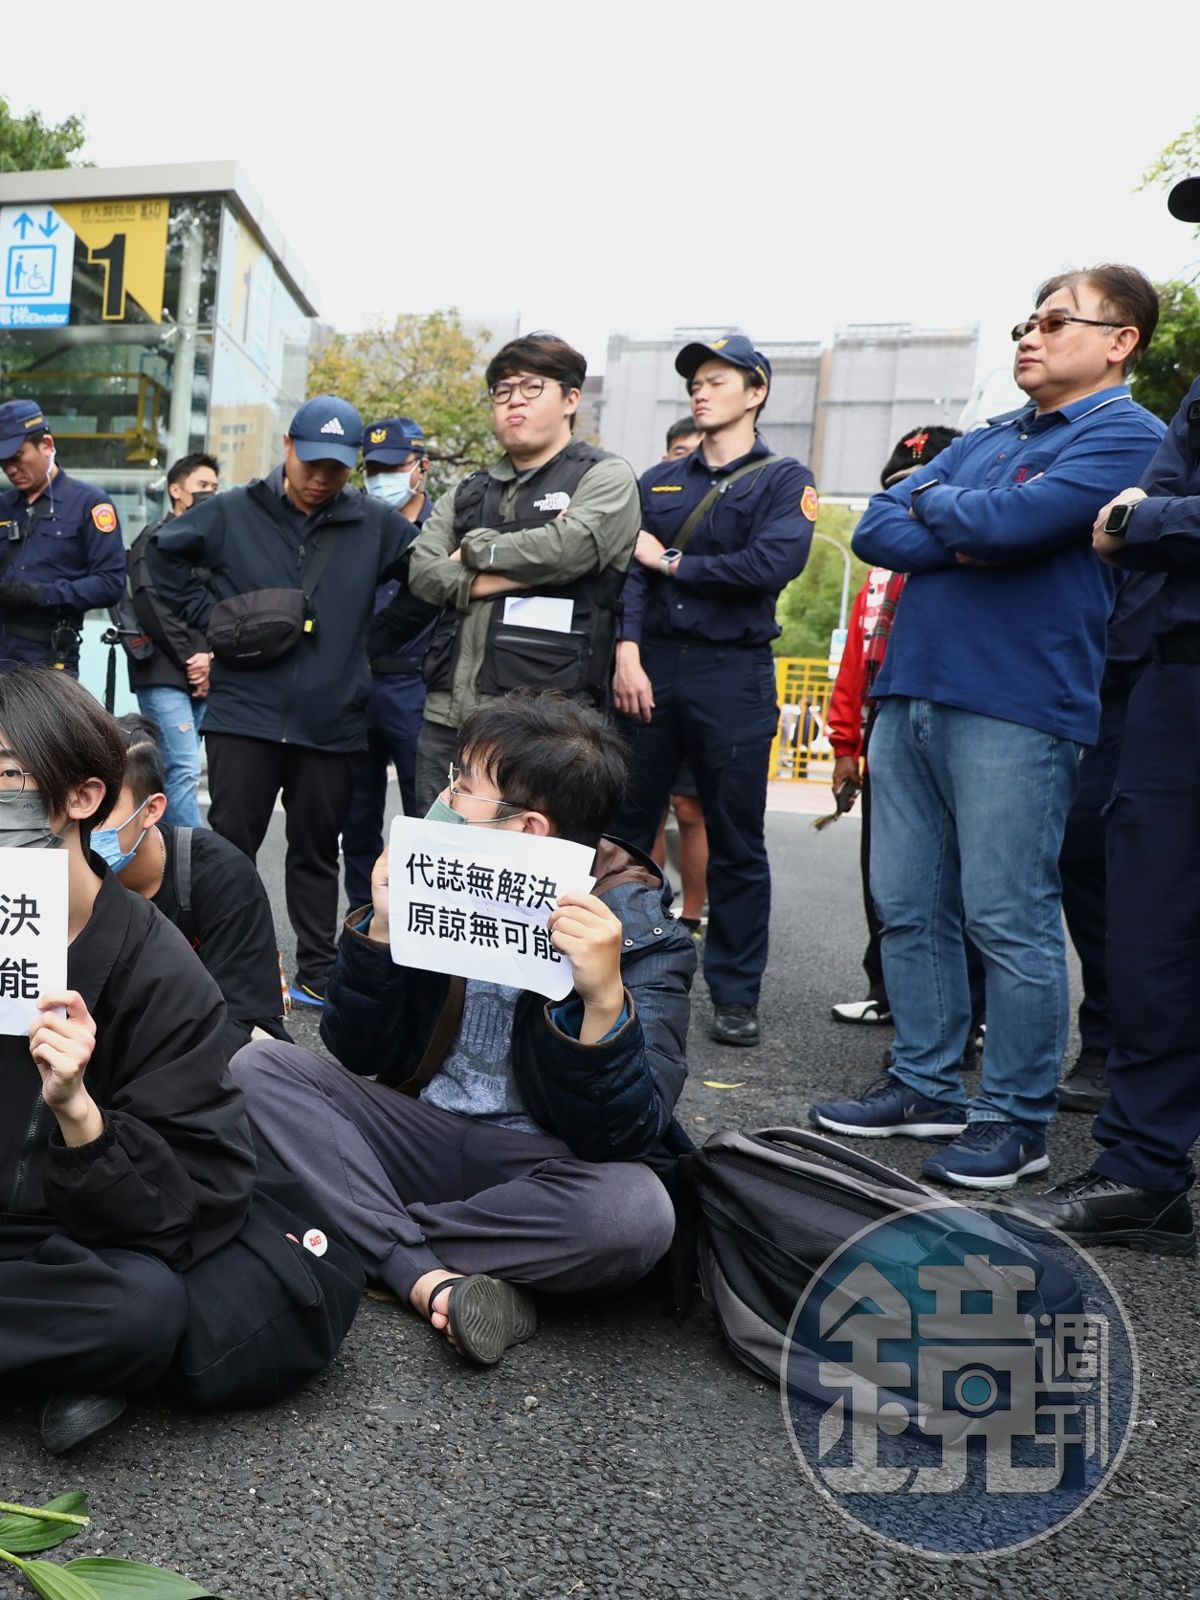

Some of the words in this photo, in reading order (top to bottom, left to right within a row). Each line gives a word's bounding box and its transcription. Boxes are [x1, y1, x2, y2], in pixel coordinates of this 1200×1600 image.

[91, 233, 127, 317] 1
[405, 853, 557, 912] 代誌無解決
[407, 901, 562, 963] 原諒無可能
